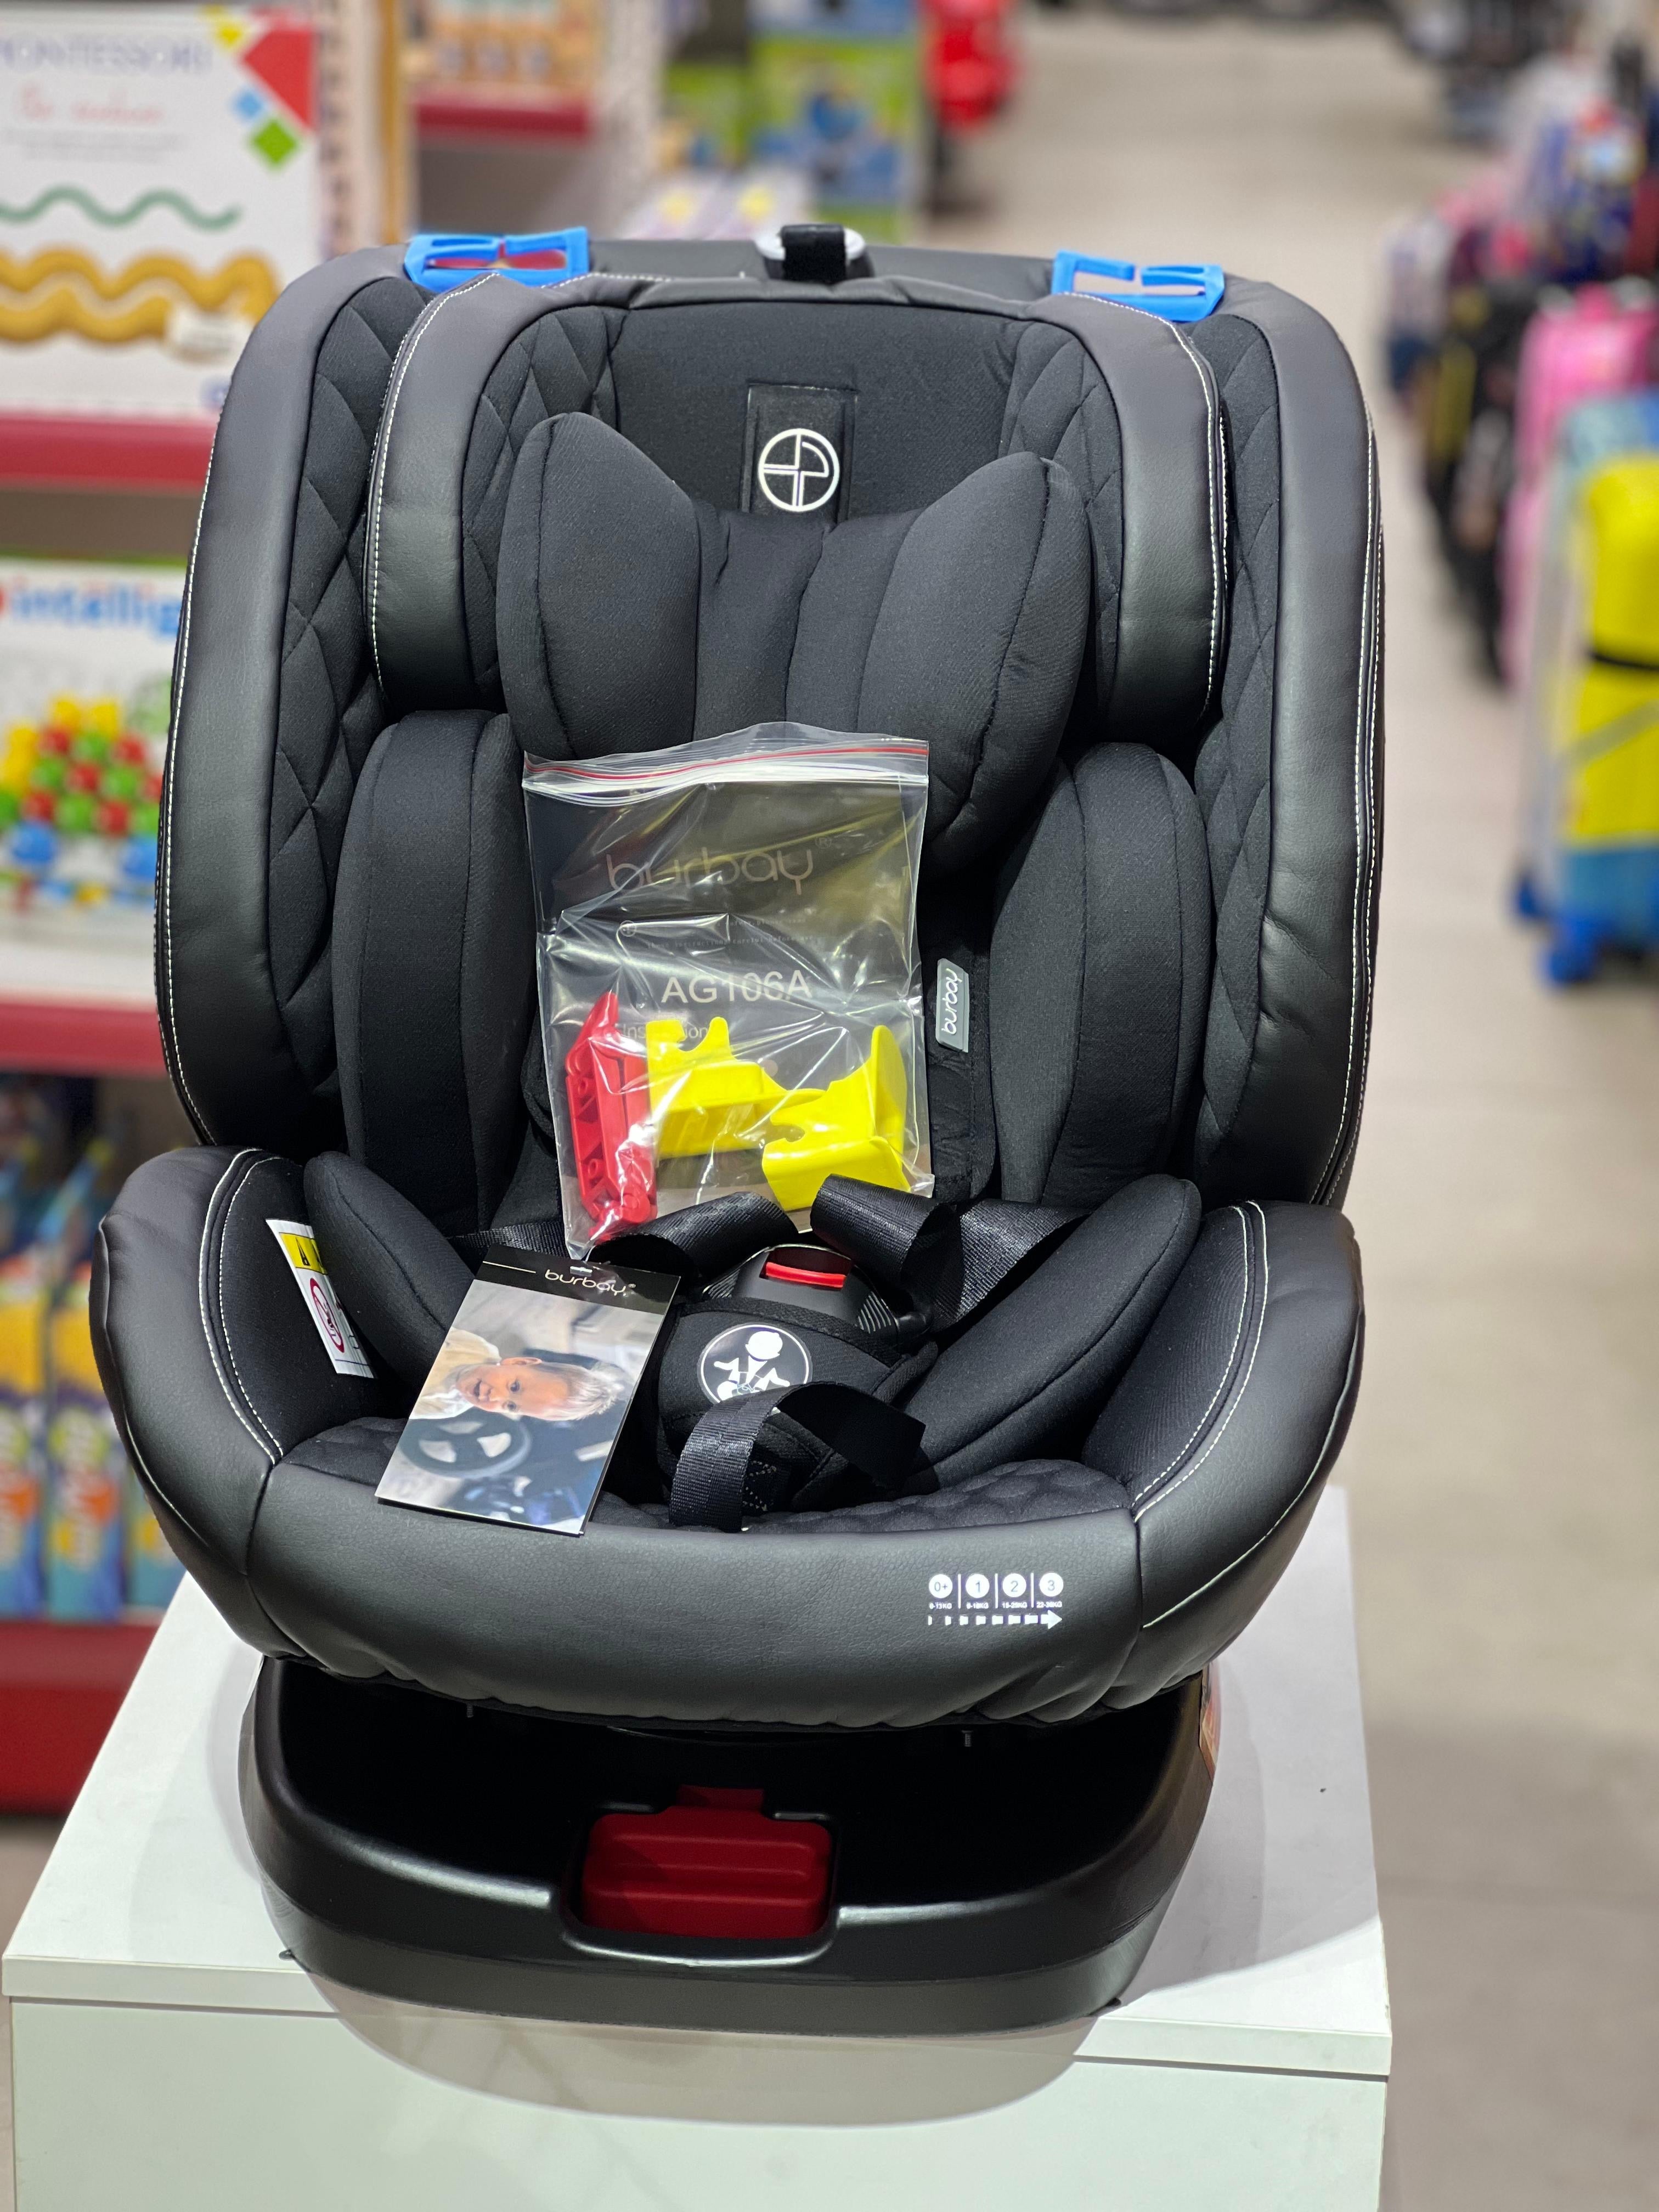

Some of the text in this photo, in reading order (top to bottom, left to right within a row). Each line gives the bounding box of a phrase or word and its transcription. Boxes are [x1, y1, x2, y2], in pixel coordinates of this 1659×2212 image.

[606, 847, 812, 895] burbay
[661, 969, 813, 1004] AG106A
[941, 968, 962, 1035] burbay
[934, 1581, 948, 1592] 0+
[1010, 1580, 1019, 1593] 2
[1047, 1579, 1055, 1592] 3
